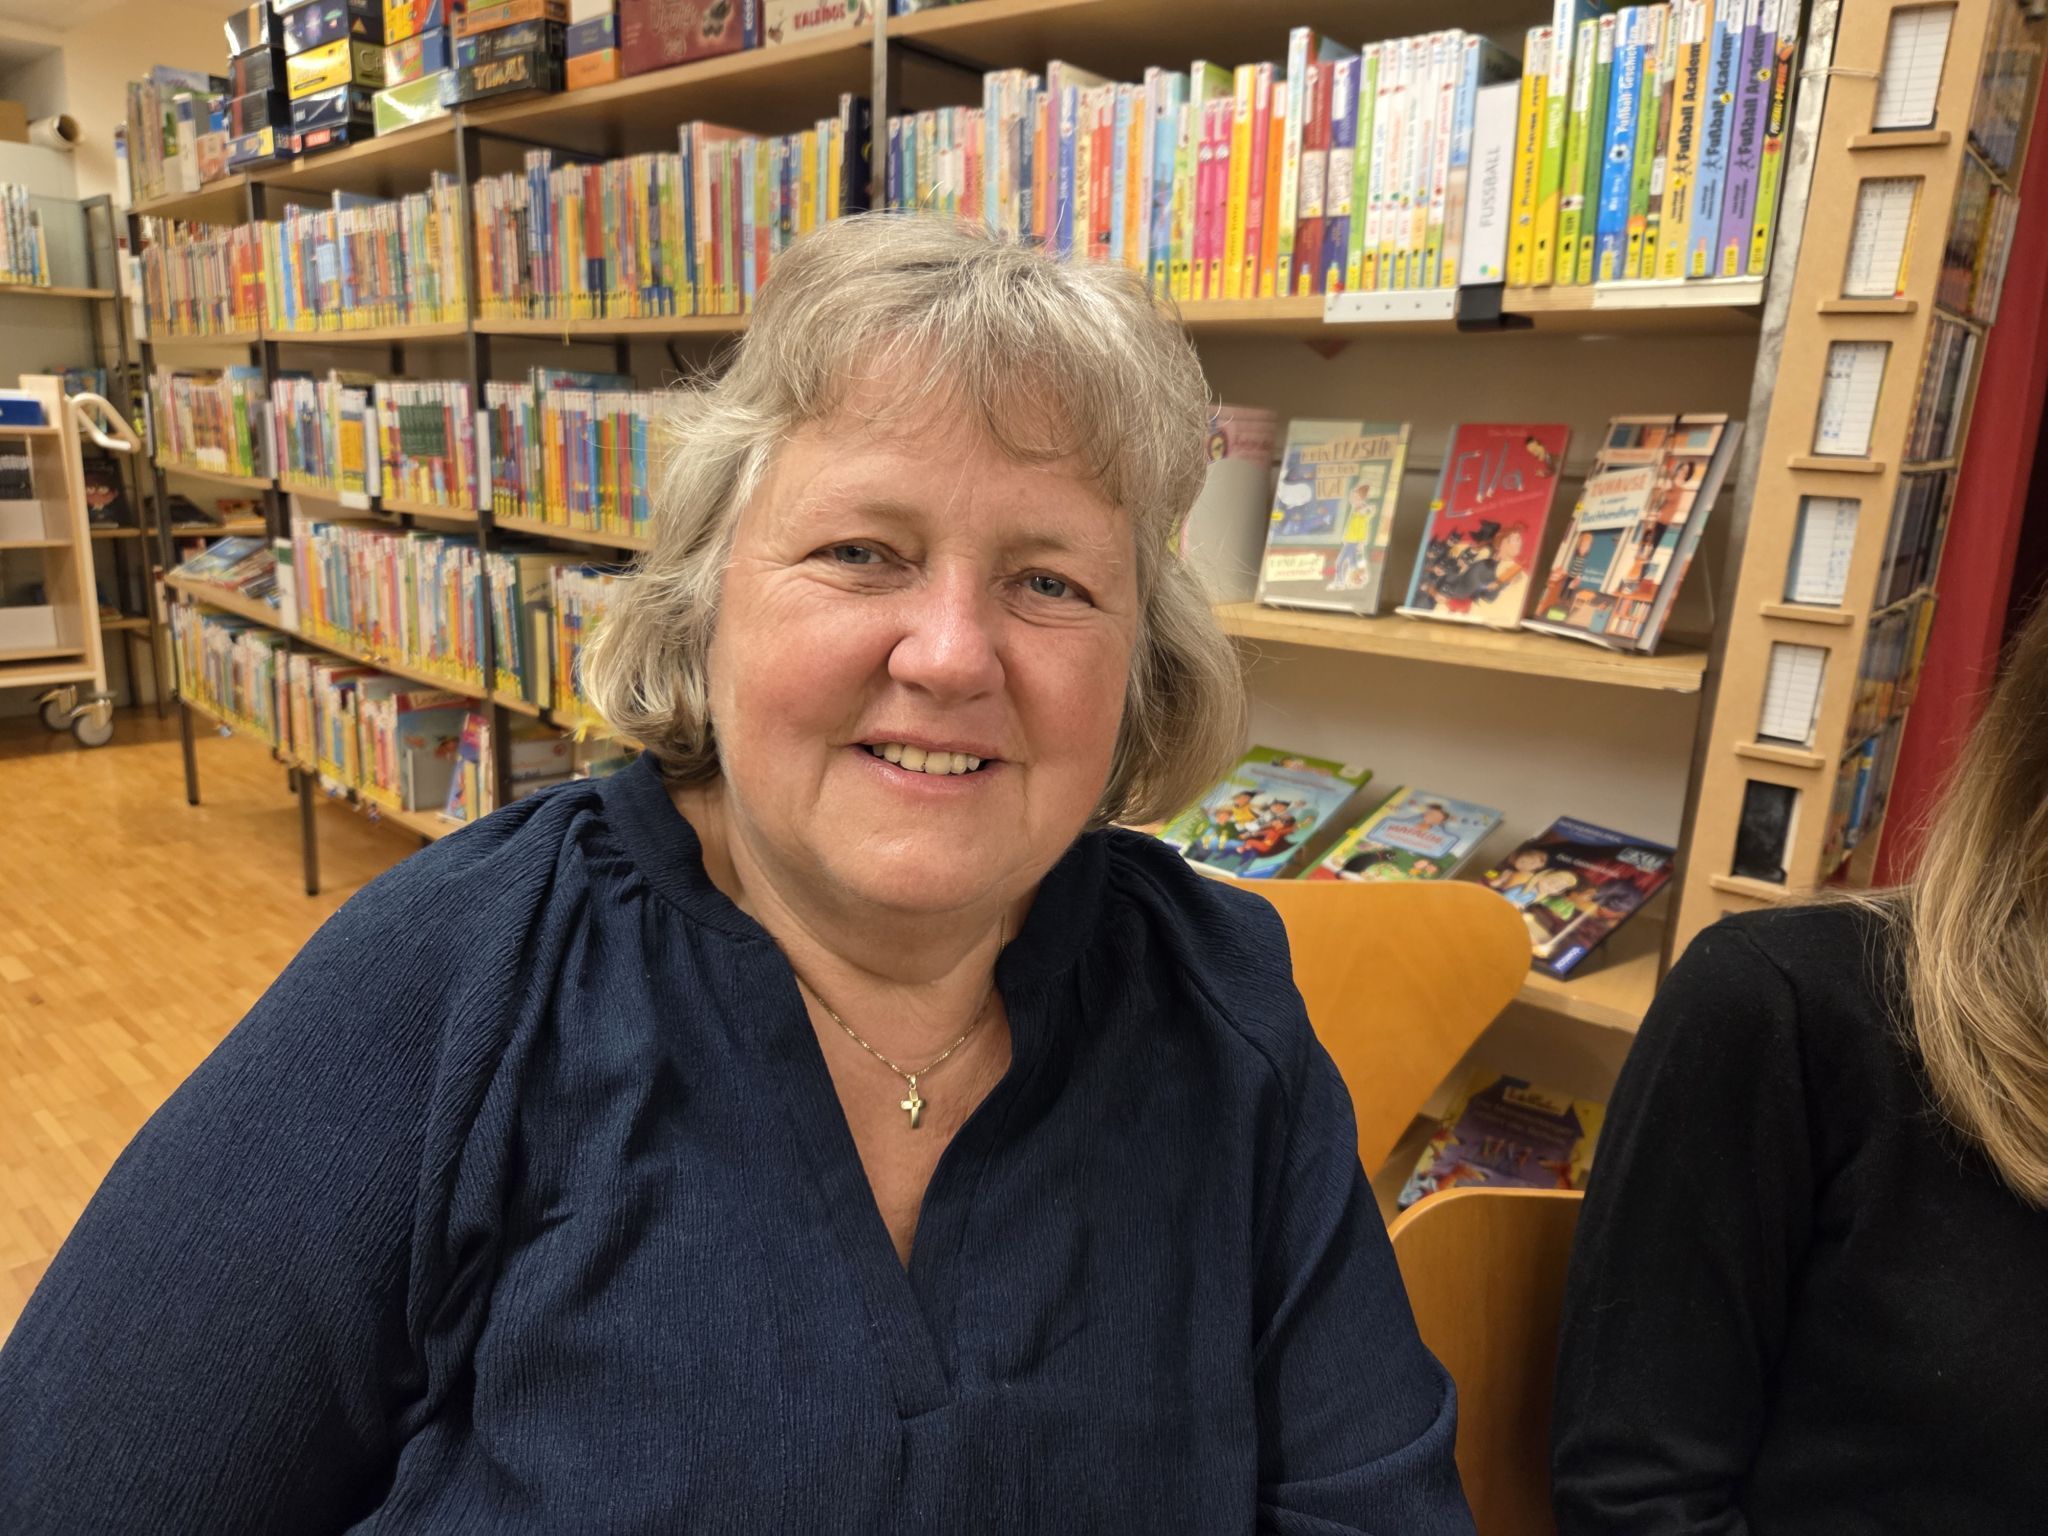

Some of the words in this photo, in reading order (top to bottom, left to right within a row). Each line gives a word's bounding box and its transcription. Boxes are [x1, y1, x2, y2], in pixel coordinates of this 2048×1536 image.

[1682, 43, 1702, 102] Academ
[1675, 106, 1695, 162] Fußball
[1705, 101, 1724, 156] Fußball
[1737, 98, 1757, 155] Fußball
[1479, 145, 1501, 228] FUSSBALL
